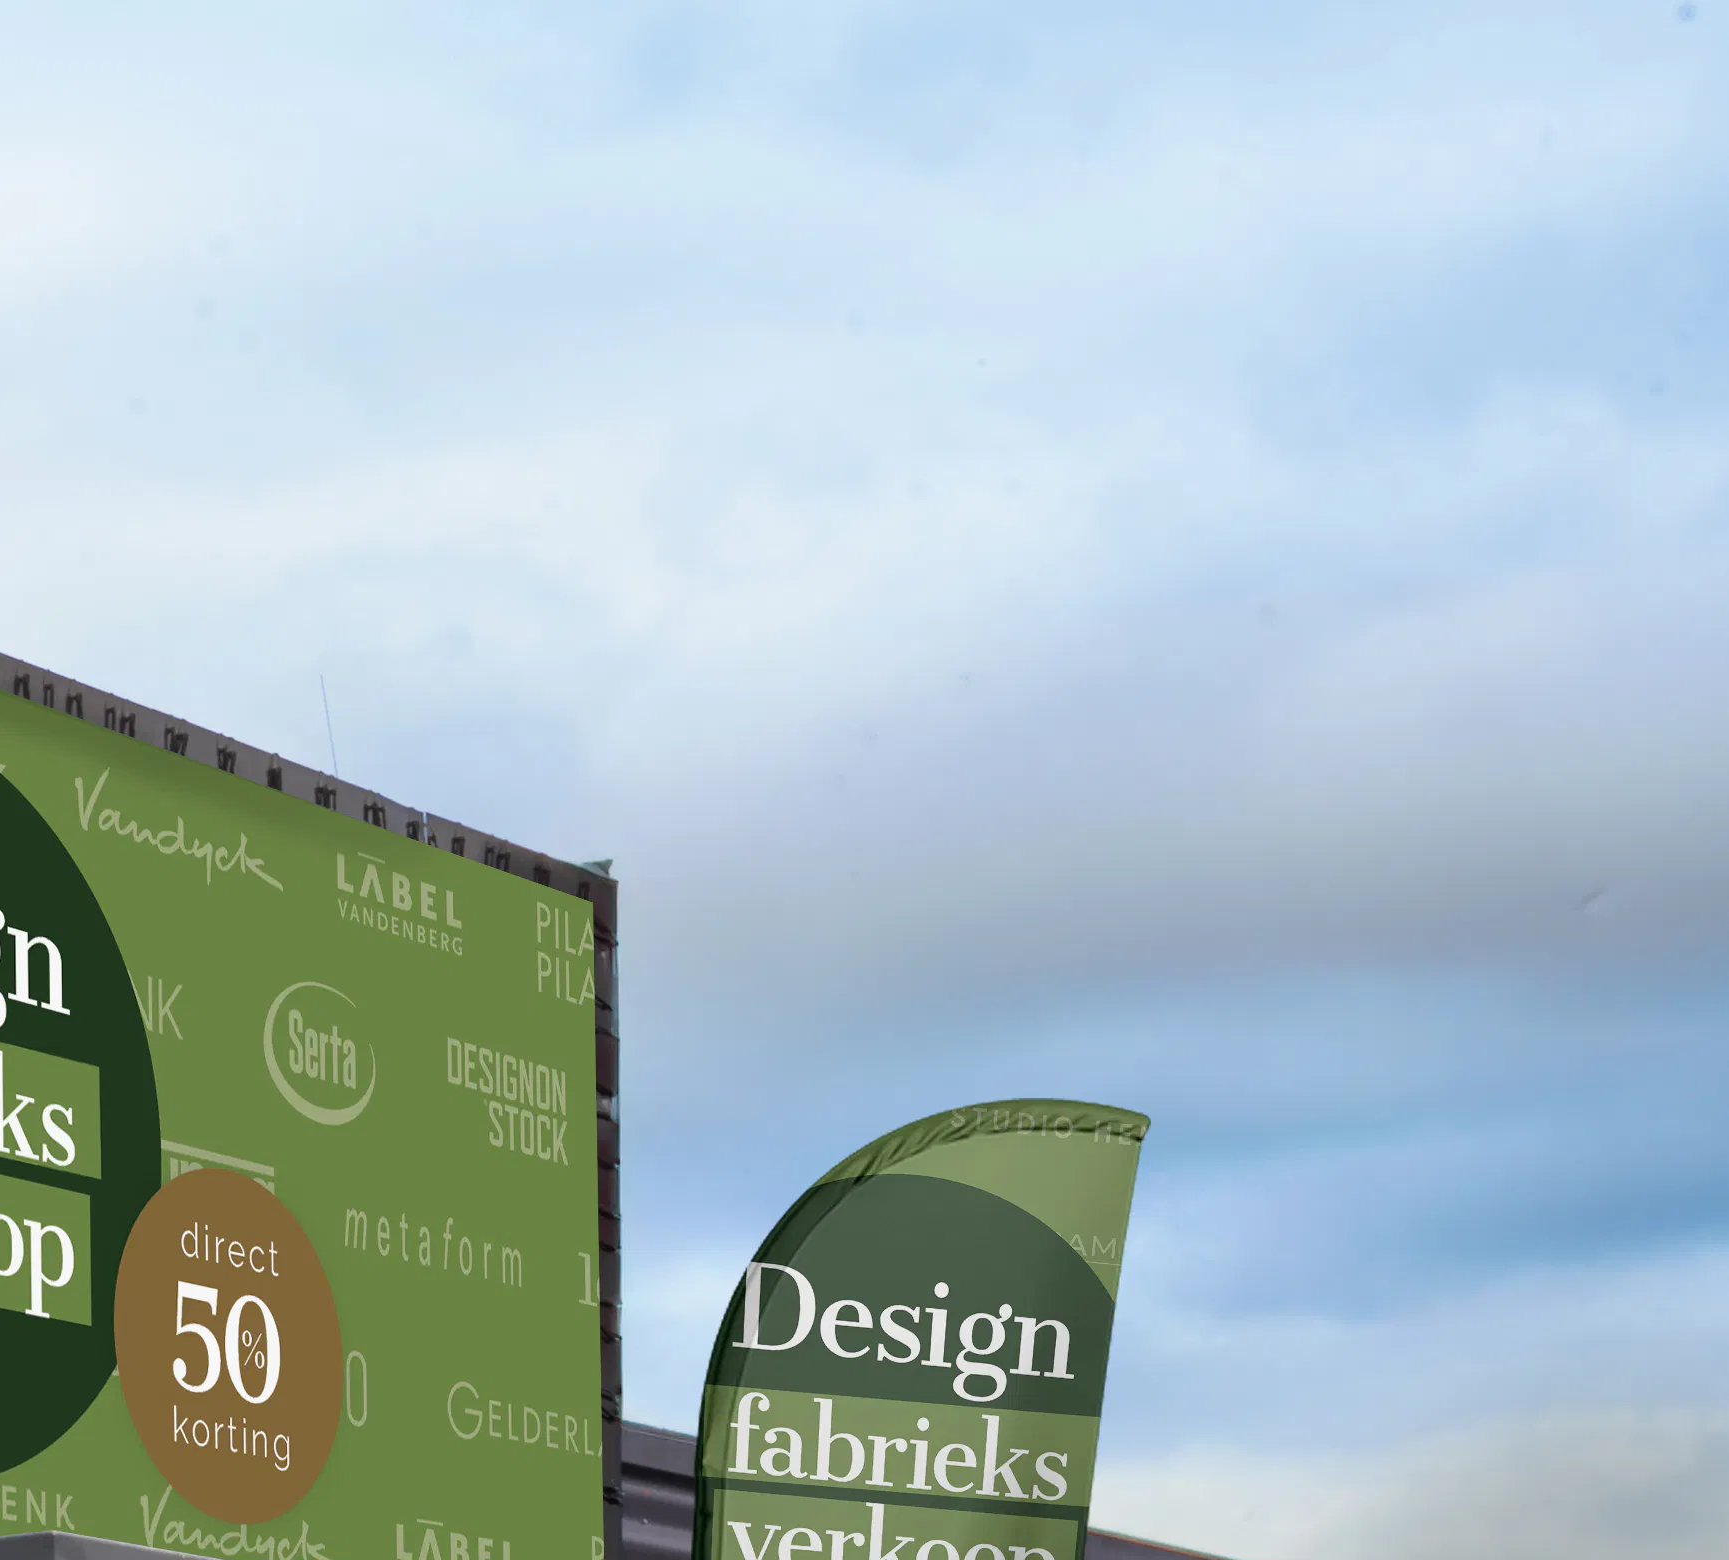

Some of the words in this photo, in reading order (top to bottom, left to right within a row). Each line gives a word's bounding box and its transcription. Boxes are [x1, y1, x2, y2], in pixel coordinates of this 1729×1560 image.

[75, 767, 284, 891] Vandyck
[338, 899, 463, 957] VANDENBERG
[288, 1009, 358, 1091] Serta
[446, 1037, 568, 1116] DESIGNON
[489, 1101, 569, 1167] STOCK
[952, 1107, 1073, 1139] STUDIO
[180, 1221, 279, 1278] direct
[344, 1207, 524, 1287] metaform
[733, 1262, 1074, 1402] Design
[174, 1405, 291, 1472] korting
[728, 1392, 1068, 1500] fabrieks
